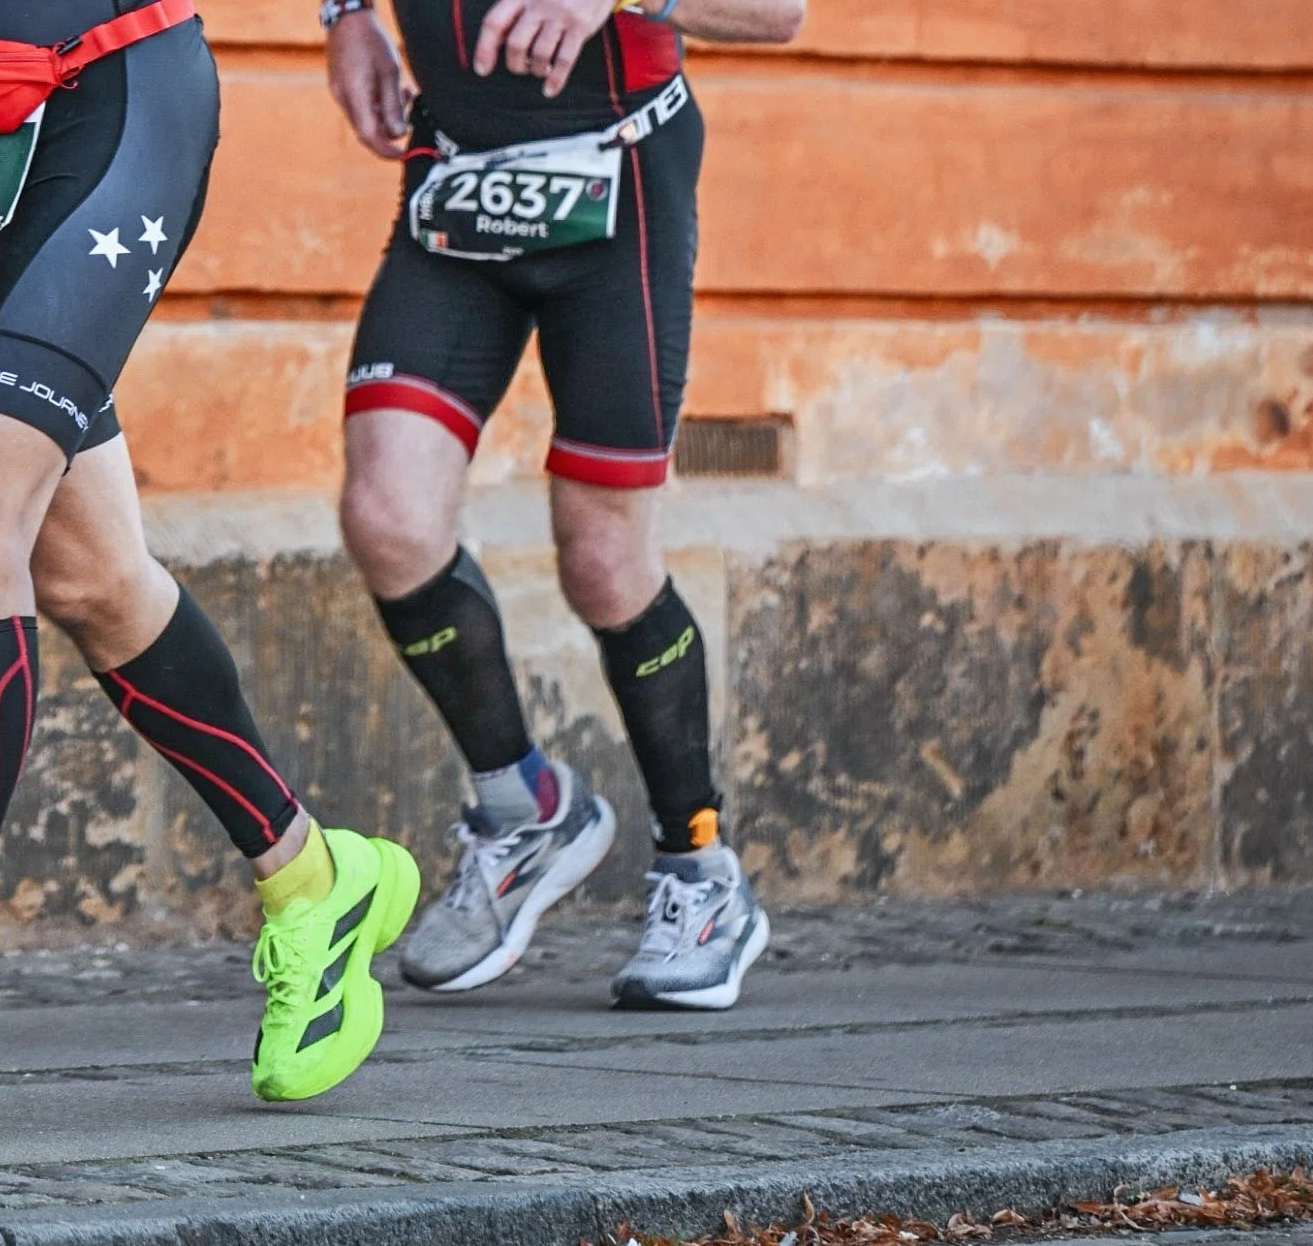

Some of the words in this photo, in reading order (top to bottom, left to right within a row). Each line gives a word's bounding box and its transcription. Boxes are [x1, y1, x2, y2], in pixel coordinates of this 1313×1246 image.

[444, 170, 586, 221] 2637
[476, 215, 549, 239] Robert
[635, 625, 695, 678] cep
